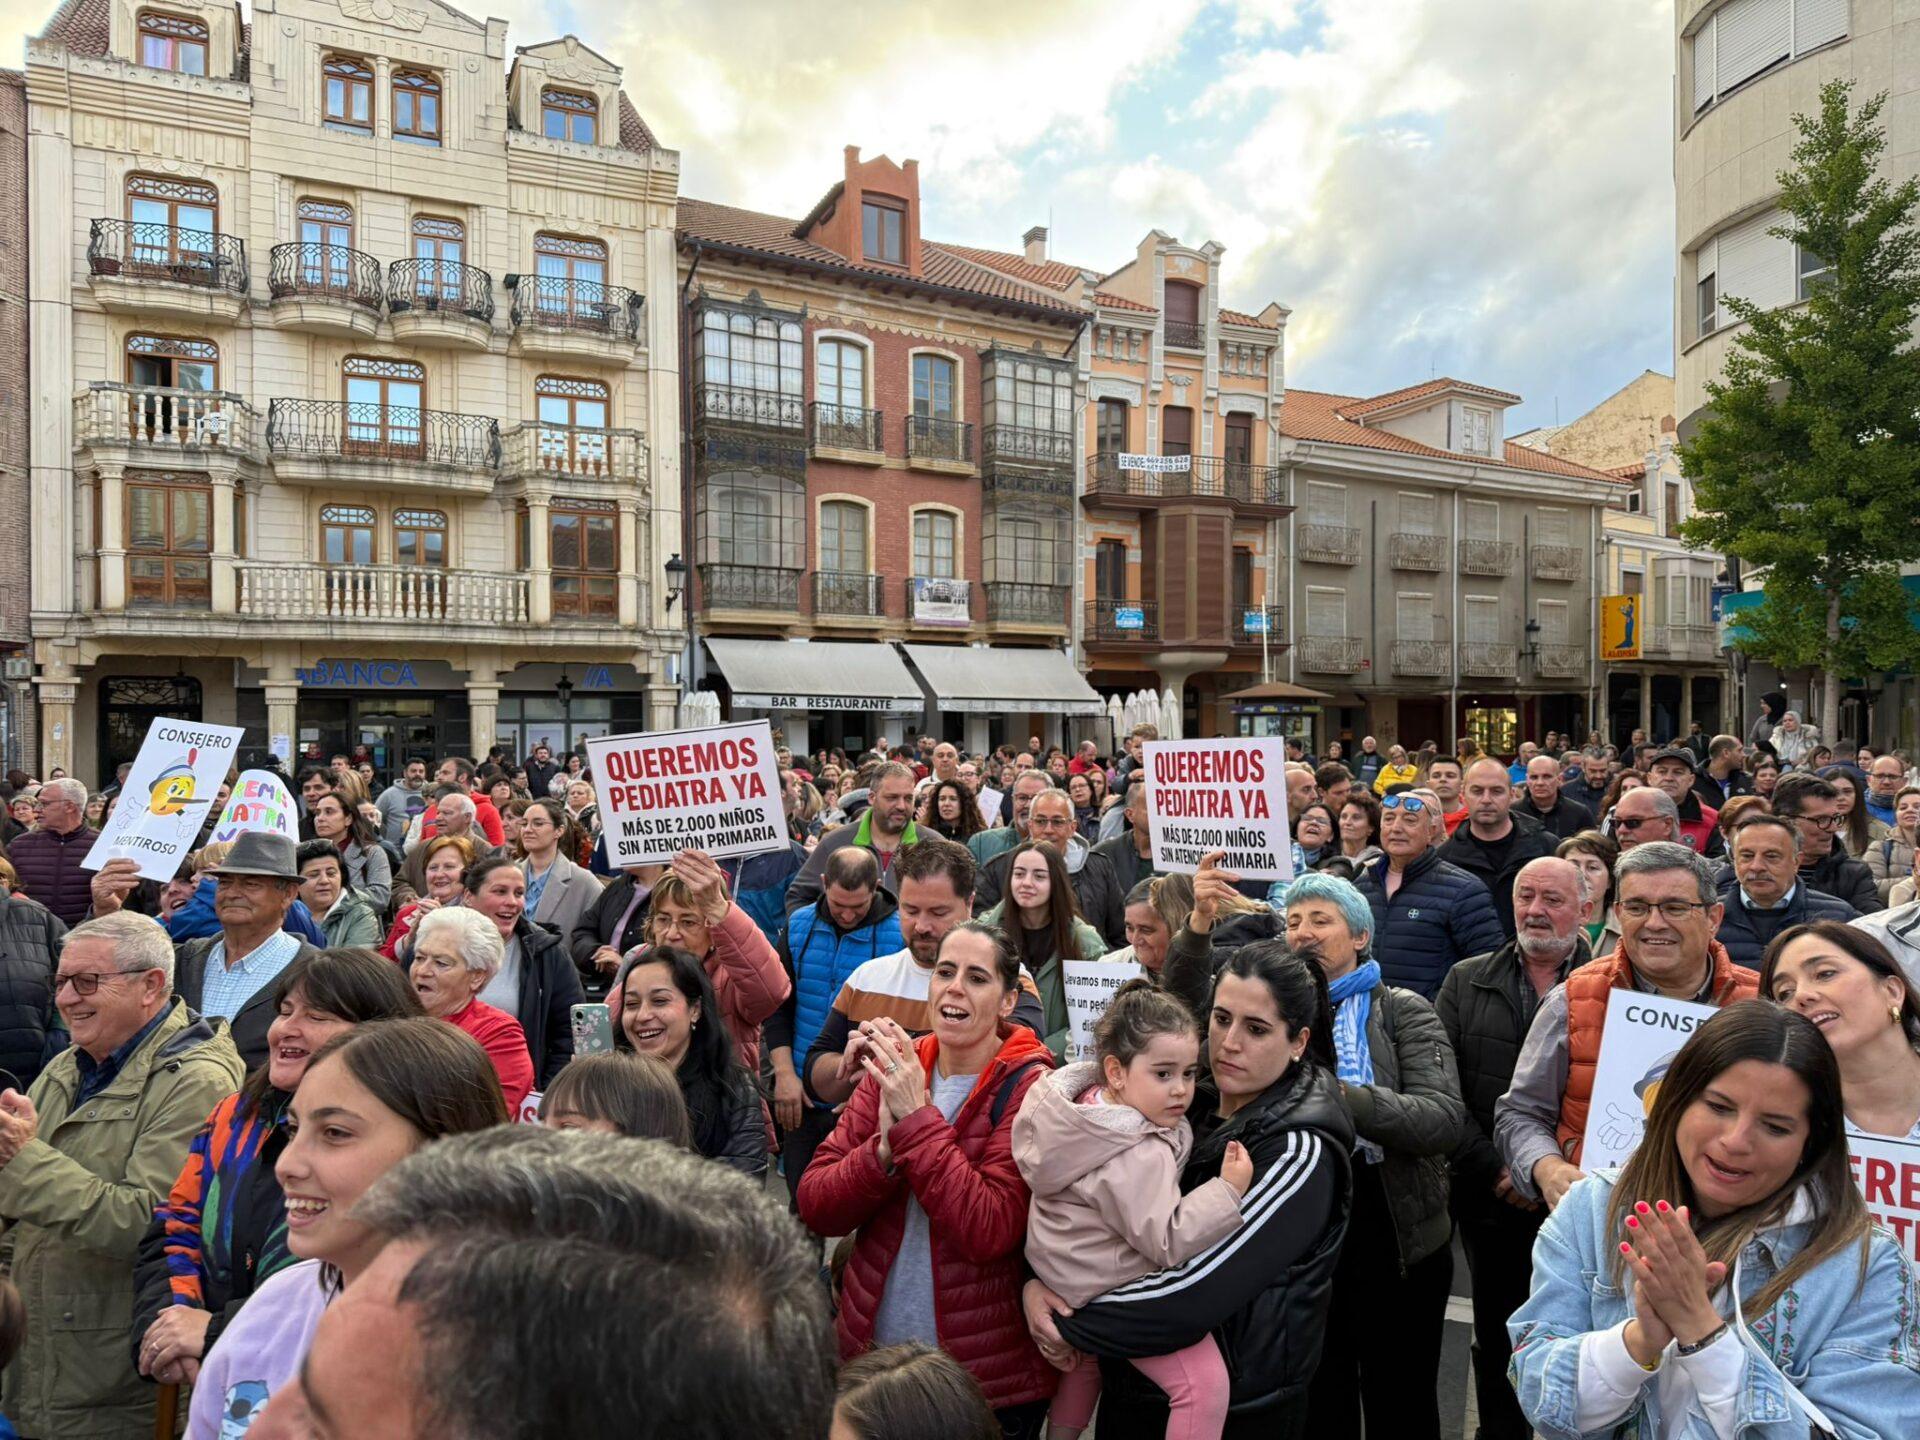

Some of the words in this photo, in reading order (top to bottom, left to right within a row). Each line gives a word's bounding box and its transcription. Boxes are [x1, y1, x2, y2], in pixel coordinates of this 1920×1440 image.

[771, 696, 797, 708] BAR
[807, 697, 892, 710] RESTAURANTE
[158, 727, 232, 749] CONSEJERO
[606, 737, 758, 784] QUEREMOS
[1155, 749, 1265, 786] QUEREMOS
[609, 777, 727, 812] PEDIATRA
[731, 772, 767, 800] YA
[1155, 789, 1234, 819] PEDIATRA
[1239, 789, 1270, 819] YA
[622, 817, 653, 837] MÁS
[656, 818, 673, 834] DE
[675, 814, 716, 833] 2.000
[719, 807, 765, 827] NIÑOS
[114, 835, 178, 855] MENTIROSO
[618, 840, 640, 856] SIN
[643, 832, 704, 853] ATENCIÓN
[708, 825, 777, 848] PRIMARIA
[1162, 824, 1180, 845] MÁS
[1181, 828, 1192, 845] DE
[1194, 829, 1222, 847] 2.000
[1225, 827, 1266, 848] NIÑOS
[1160, 847, 1174, 863] SIN
[1214, 852, 1277, 870] PRIMARIA
[1067, 995, 1076, 1007] sin
[1078, 998, 1087, 1008] un
[1076, 1043, 1081, 1056] y
